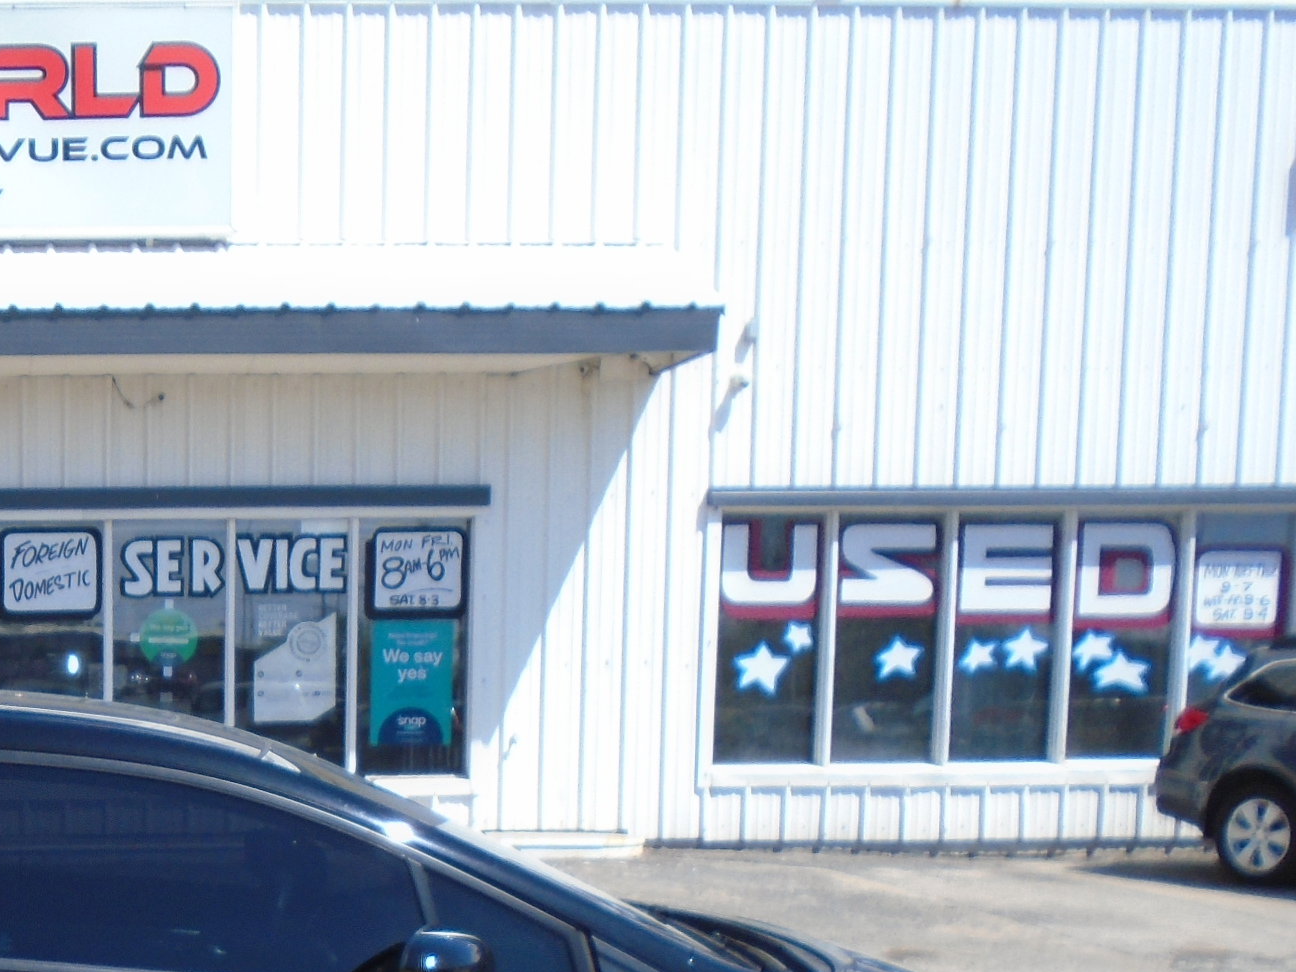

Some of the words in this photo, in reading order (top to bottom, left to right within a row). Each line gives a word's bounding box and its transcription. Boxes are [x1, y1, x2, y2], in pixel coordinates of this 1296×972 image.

[10, 536, 89, 569] FOREIGN
[381, 537, 413, 553] MON
[120, 533, 347, 598] SERVICE
[721, 520, 1180, 626] USED
[9, 570, 91, 602] DOMESTIC
[383, 648, 410, 664] We
[414, 651, 443, 667] say
[398, 668, 426, 684] yes
[398, 715, 426, 728] snap
